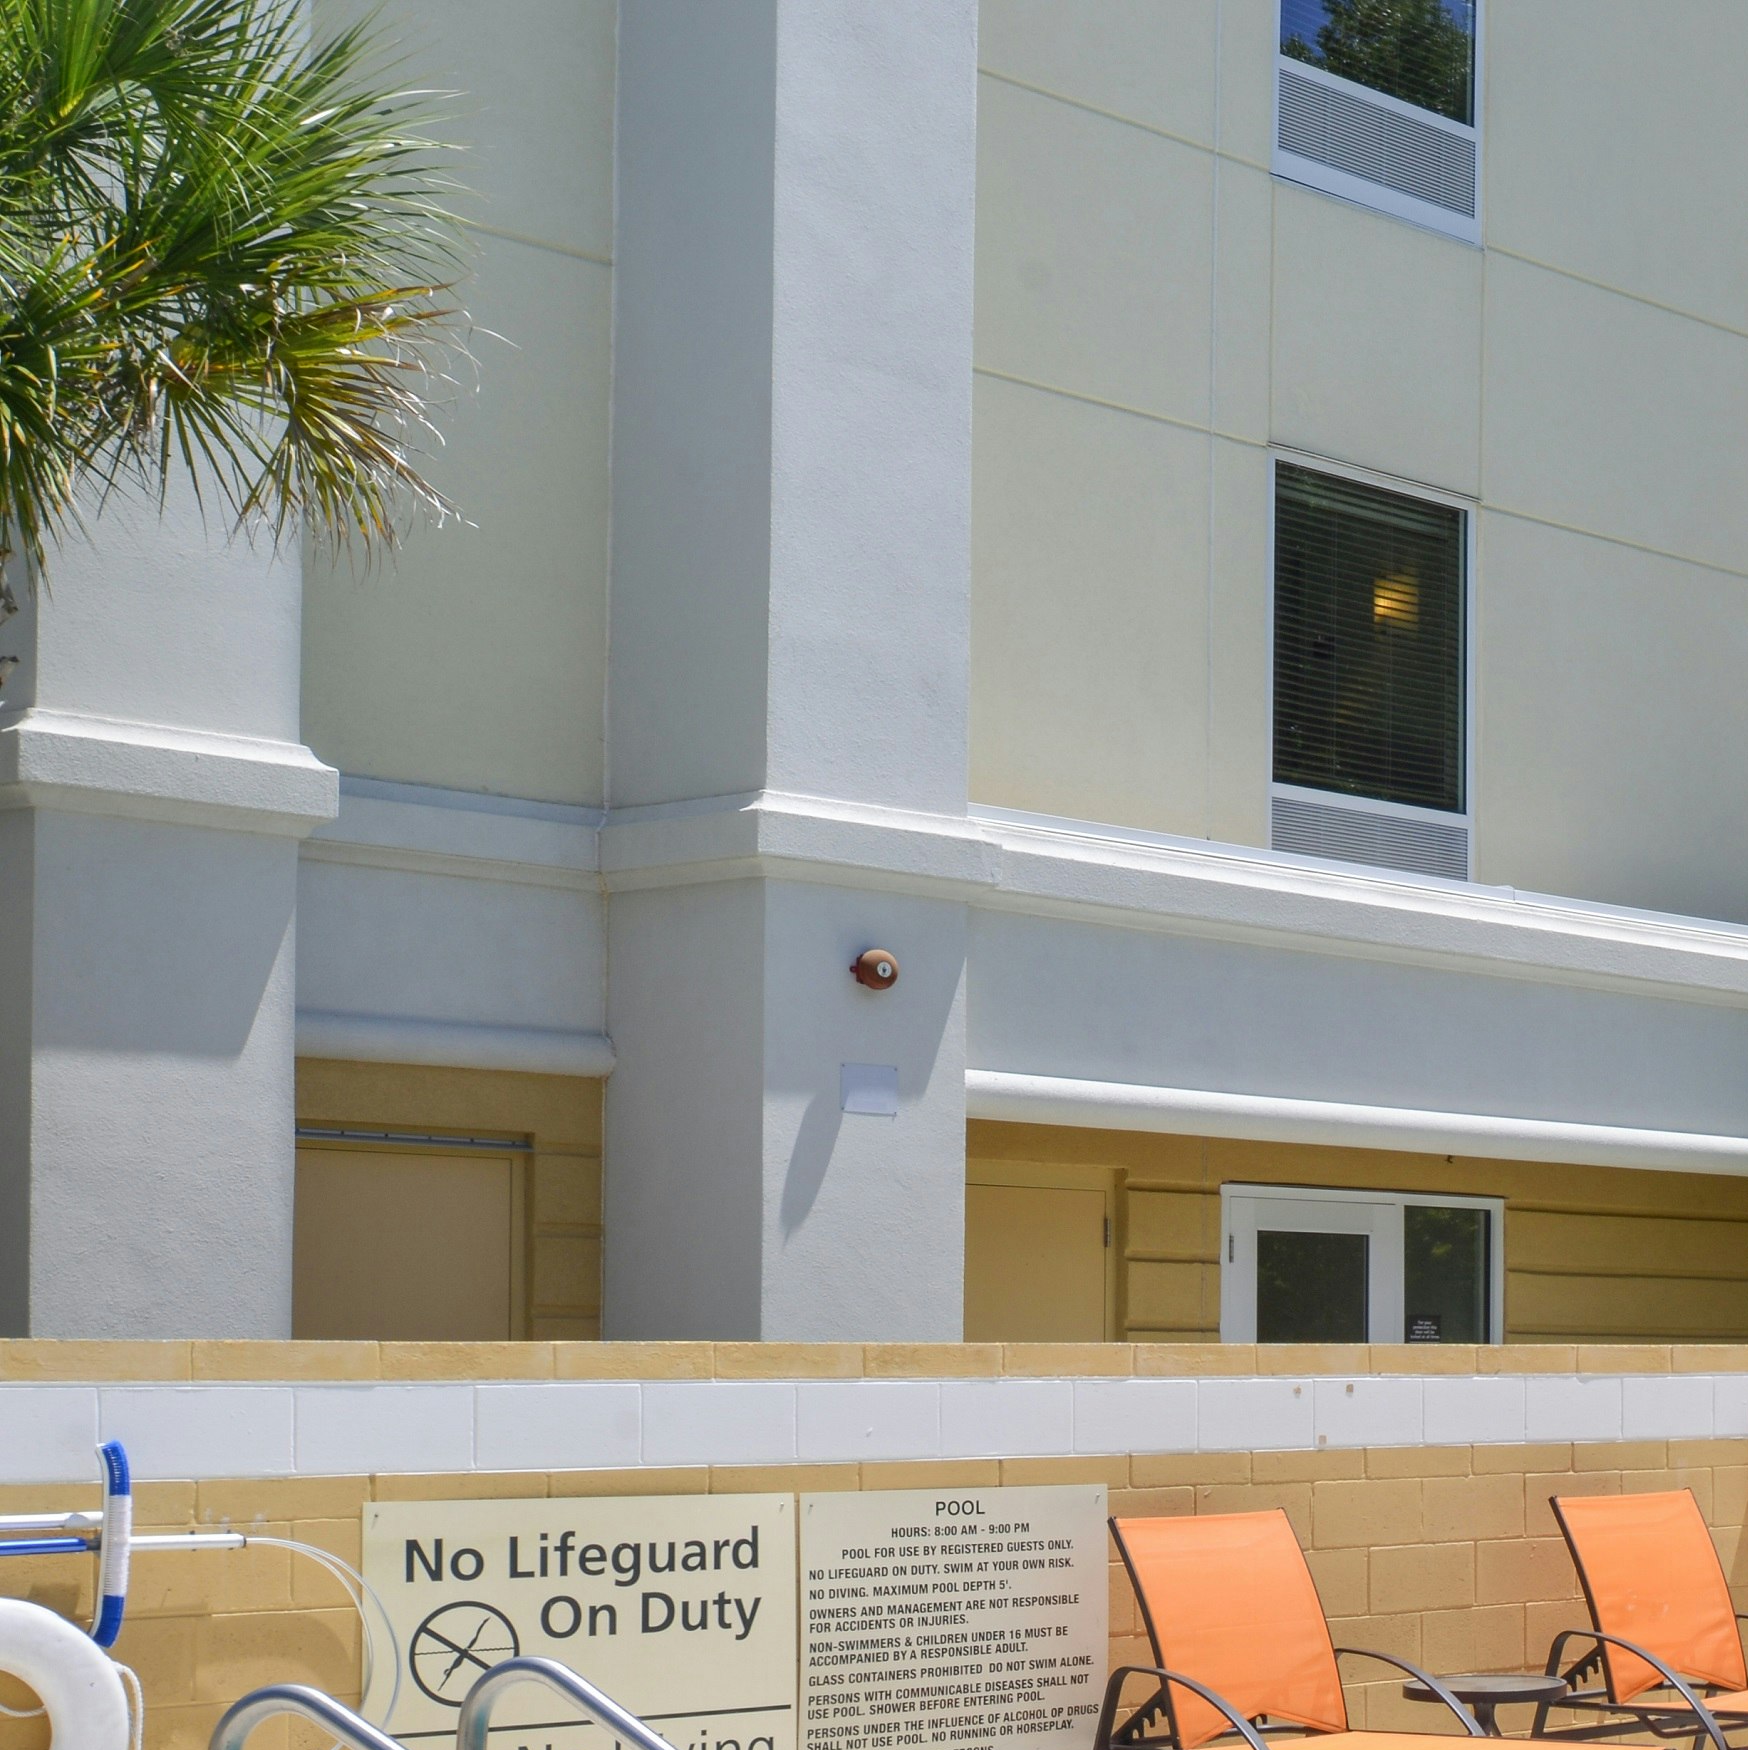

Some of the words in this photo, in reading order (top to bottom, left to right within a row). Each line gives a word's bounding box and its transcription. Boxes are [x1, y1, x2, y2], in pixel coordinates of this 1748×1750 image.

[936, 1500, 985, 1516] POOL
[891, 1526, 931, 1538] HOURS:
[934, 1525, 957, 1536] 8:00
[960, 1524, 977, 1536] AM
[989, 1523, 1011, 1534] 9:00
[1014, 1522, 1029, 1533] PM
[405, 1538, 485, 1583] No
[509, 1525, 759, 1587] Lifeguard
[842, 1548, 871, 1560] POOL
[874, 1547, 895, 1558] FOR
[899, 1546, 920, 1557] USE
[923, 1545, 938, 1556] BY
[941, 1542, 1003, 1555] REGISTERED
[1007, 1540, 1045, 1552] GUESTS
[1048, 1539, 1074, 1550] ONLY.
[809, 1569, 824, 1580] NO
[828, 1566, 888, 1579] LIFEGUARD
[892, 1565, 907, 1576] ON
[911, 1564, 940, 1575] DUTY.
[944, 1562, 973, 1574] SWIM
[976, 1561, 989, 1573] AT
[992, 1560, 1019, 1571] YOUR
[1022, 1559, 1045, 1569] OWN
[1048, 1557, 1074, 1568] RISK.
[809, 1589, 825, 1600] NO
[828, 1587, 869, 1599] DIVING.
[873, 1584, 928, 1597] MAXIMUM
[932, 1582, 960, 1594] POOL
[963, 1580, 996, 1592] DEPTH
[540, 1595, 617, 1639] On
[641, 1591, 762, 1641] Duty
[809, 1607, 857, 1620] OWNERS
[861, 1605, 884, 1616] AND
[887, 1601, 964, 1615] MANAGEMENT
[965, 1599, 986, 1610] ARE
[989, 1598, 1009, 1609] NOT
[1012, 1594, 1079, 1608] RESPONSIBLE
[810, 1622, 831, 1633] FOR
[835, 1617, 896, 1632] ACCIDENTS
[899, 1616, 914, 1628] OR
[918, 1614, 969, 1627] INJURIES.
[809, 1637, 902, 1653] NON-SWIMMERS
[904, 1636, 912, 1647] &
[916, 1633, 968, 1646] CHILDREN
[971, 1630, 1007, 1642] UNDER
[1009, 1629, 1021, 1639] 16
[1025, 1627, 1052, 1638] MUST
[1056, 1626, 1068, 1636] BE
[809, 1651, 889, 1667] ACCOMPANIED
[893, 1650, 907, 1661] BY
[910, 1650, 917, 1660] A
[920, 1645, 991, 1659] RESPONSIBLE
[995, 1642, 1028, 1653] ADULT.
[809, 1674, 844, 1686] GLASS
[848, 1668, 917, 1684] CONTAINERS
[989, 1661, 1003, 1673] DO
[1006, 1660, 1026, 1671] NOT
[1028, 1658, 1056, 1670] SWIM
[1060, 1655, 1094, 1667] ALONE.
[808, 1692, 860, 1706] PERSONS
[864, 1689, 892, 1702] WITH
[896, 1682, 983, 1699] COMMUNICABLE
[985, 1678, 1034, 1692] DISEASES
[1036, 1675, 1068, 1688] SHALL
[1070, 1673, 1090, 1685] NOT
[808, 1708, 830, 1720] USE
[833, 1706, 865, 1718] POOL.
[869, 1701, 916, 1715] SHOWER
[919, 1698, 961, 1711] BEFORE
[964, 1693, 1013, 1708] ENTERING
[1017, 1690, 1045, 1702] POOL.
[807, 1725, 860, 1739] PERSONS
[863, 1722, 900, 1735] UNDER
[904, 1720, 924, 1731] THE
[928, 1714, 986, 1729] INFLUENCE
[988, 1713, 1001, 1724] OF
[1003, 1709, 1048, 1723] ALCOHOL
[1067, 1704, 1099, 1716] DRUGS
[846, 1738, 868, 1750] NOT
[872, 1736, 893, 1748] USE
[896, 1732, 928, 1745] POOL.
[932, 1730, 946, 1742] NO
[950, 1726, 996, 1740] RUNNING
[999, 1724, 1013, 1736] OR
[1016, 1719, 1074, 1734] HORSEPLAY.
